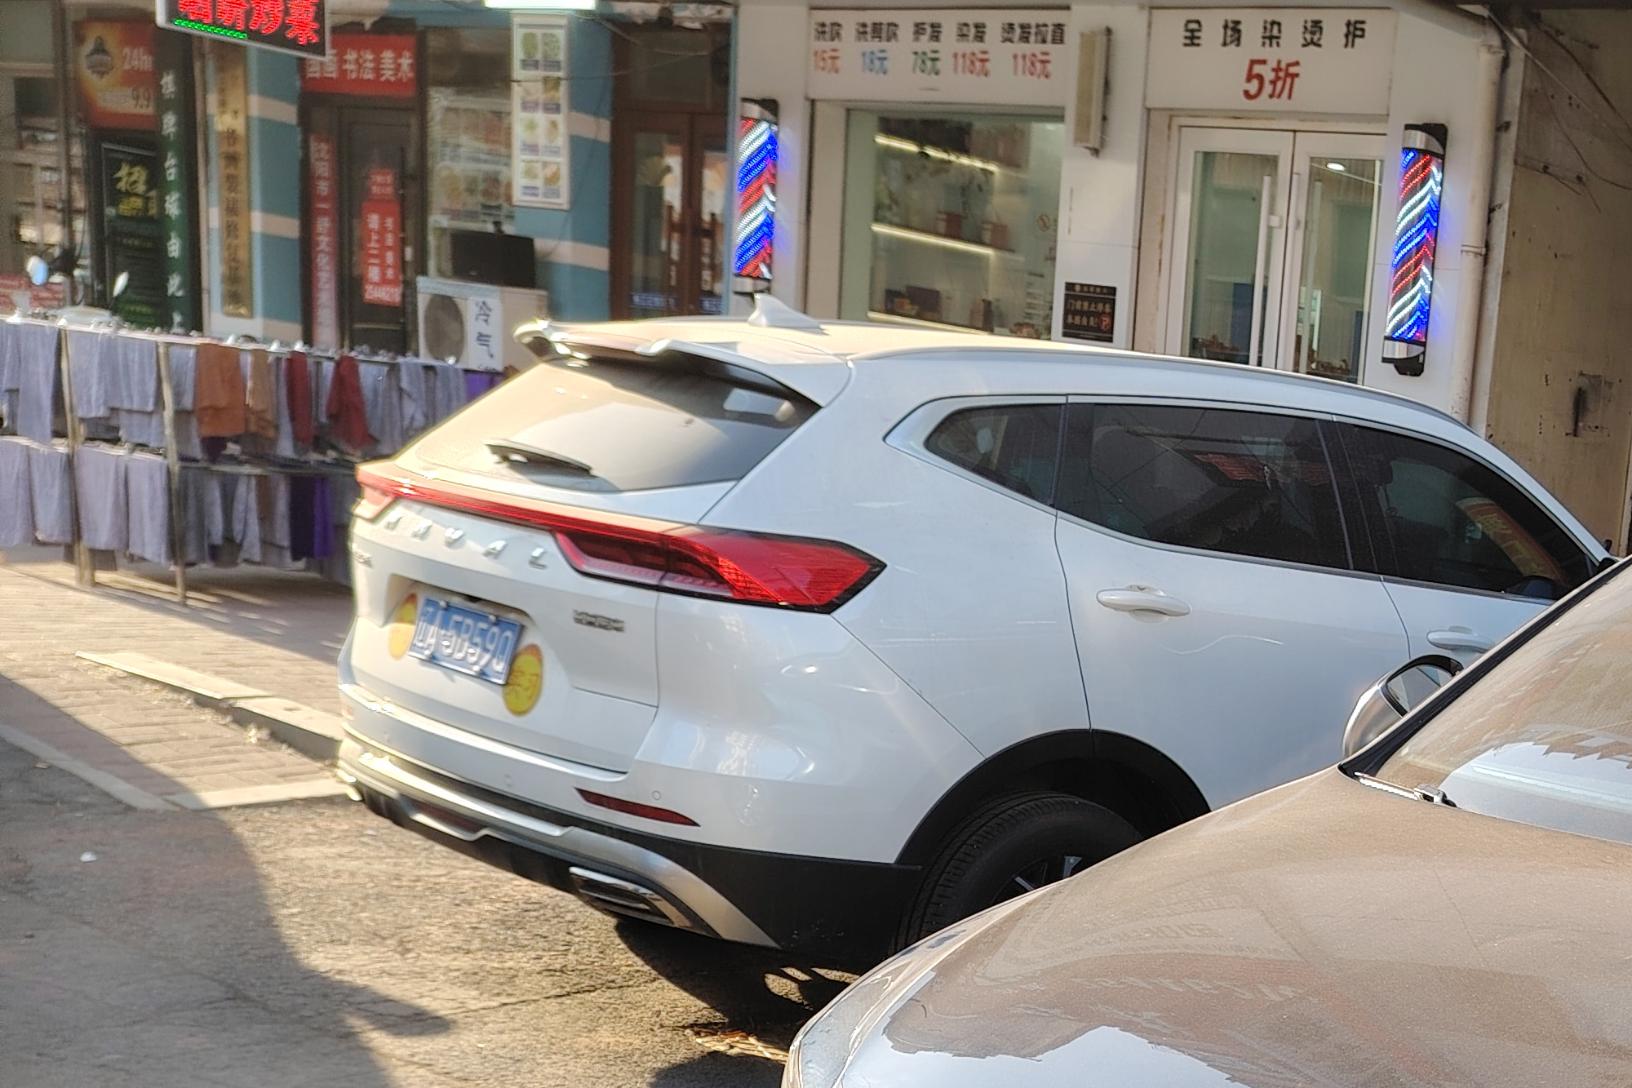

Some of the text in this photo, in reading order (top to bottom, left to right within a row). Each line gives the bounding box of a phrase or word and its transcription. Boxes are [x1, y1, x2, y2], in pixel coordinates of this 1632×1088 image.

[813, 21, 1067, 45] 洗吹 洗剪吹 护发 染发 烫发拉直
[1182, 19, 1367, 49] 全场染烫护
[343, 49, 375, 80] 书法
[379, 49, 415, 82] 美术
[861, 48, 889, 76] 18元
[911, 49, 941, 76] 78元
[952, 50, 991, 78] 118元
[1012, 51, 1052, 80] 118元
[1242, 58, 1301, 101] 5折
[475, 299, 495, 359] 冷气
